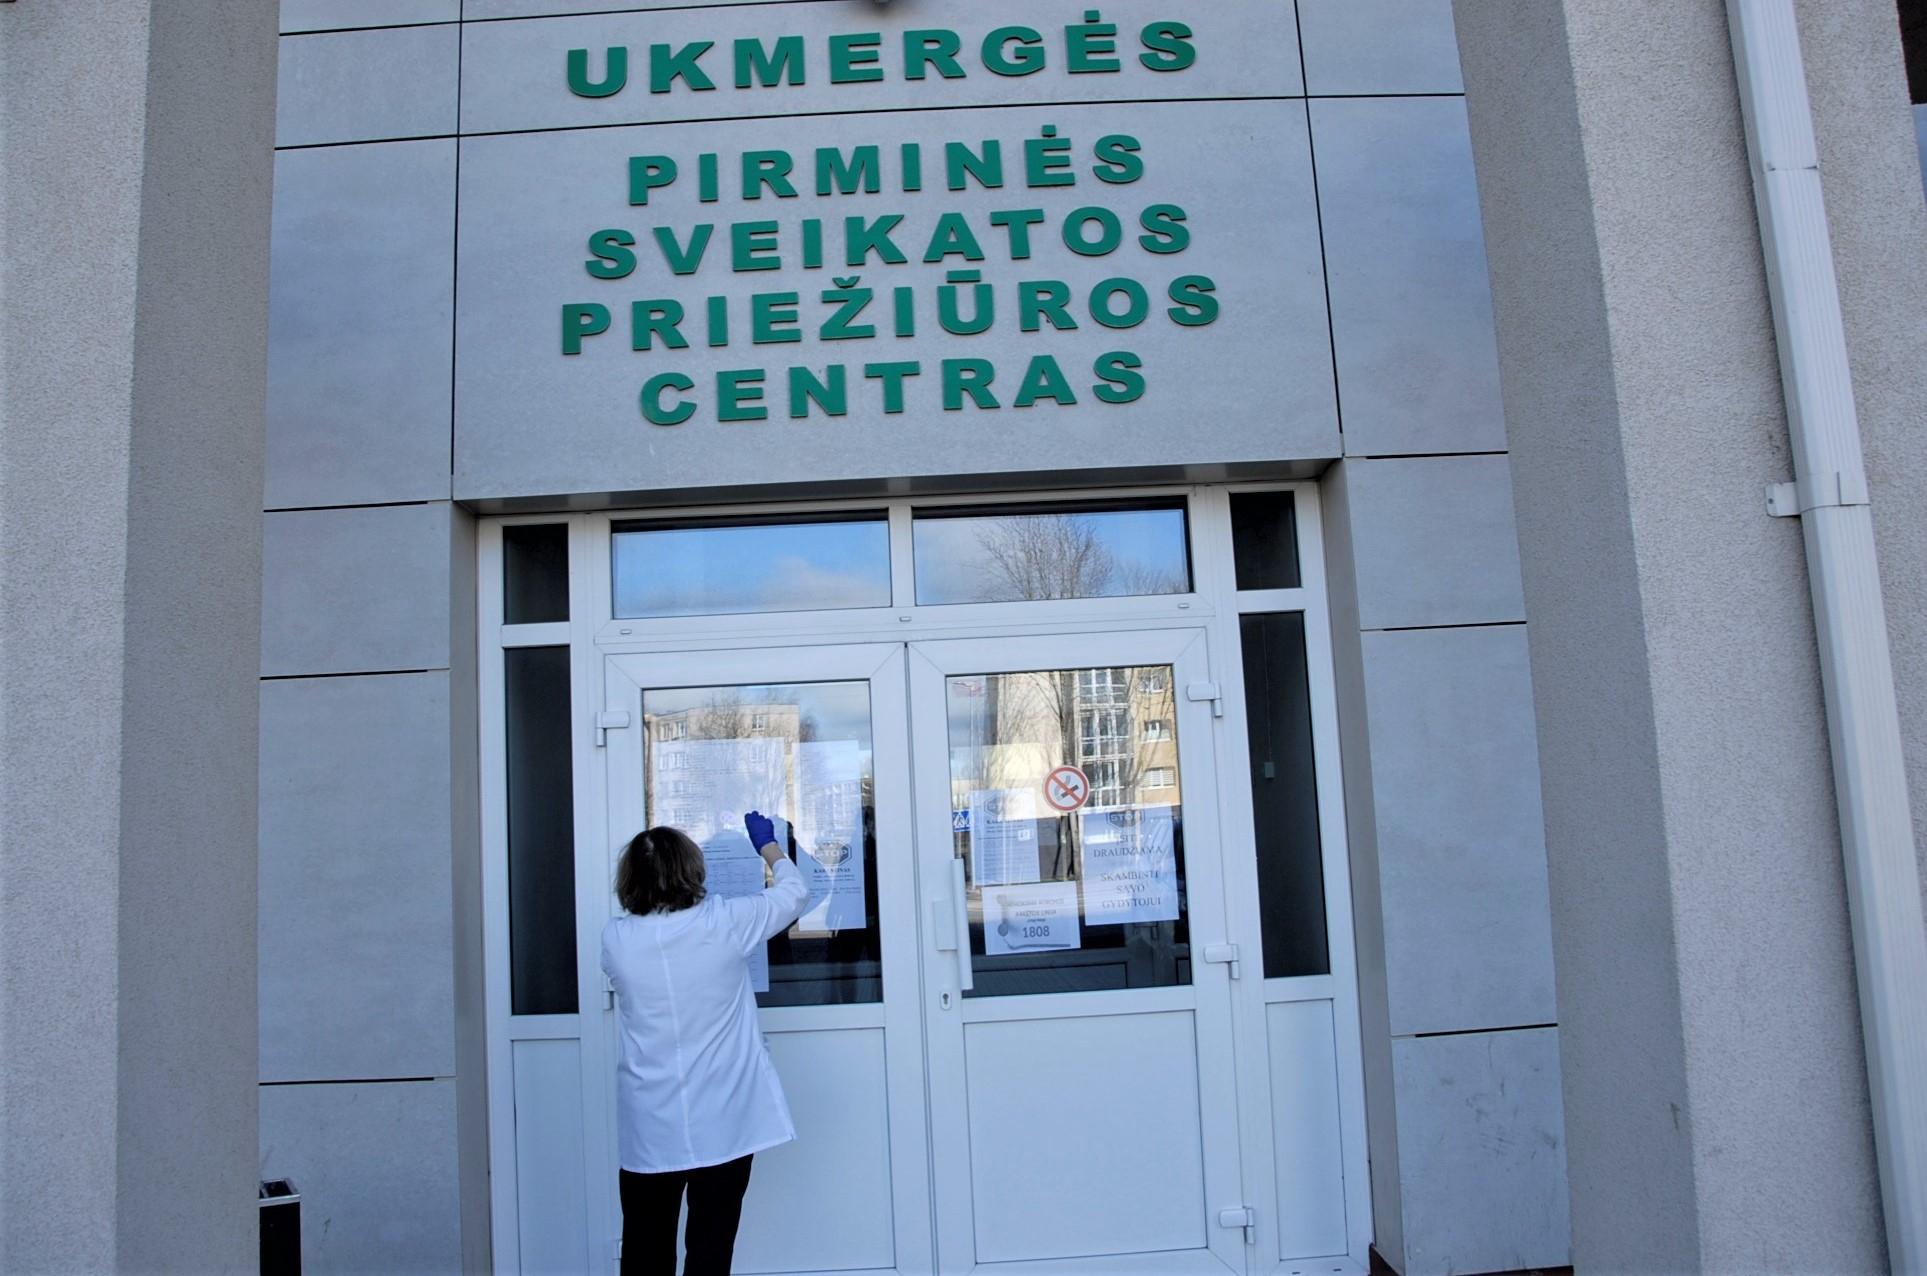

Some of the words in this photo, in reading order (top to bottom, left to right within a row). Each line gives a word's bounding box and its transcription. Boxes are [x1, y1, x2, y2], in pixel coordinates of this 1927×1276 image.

[566, 10, 1197, 98] UKMERGĖS
[628, 125, 1145, 206] PIRMINĖS
[585, 203, 1191, 280] SVEIKATOS
[561, 269, 1220, 355] PRIEŽIŪROS
[640, 351, 1147, 426] CENTRAS
[1022, 925, 1050, 938] 1808
